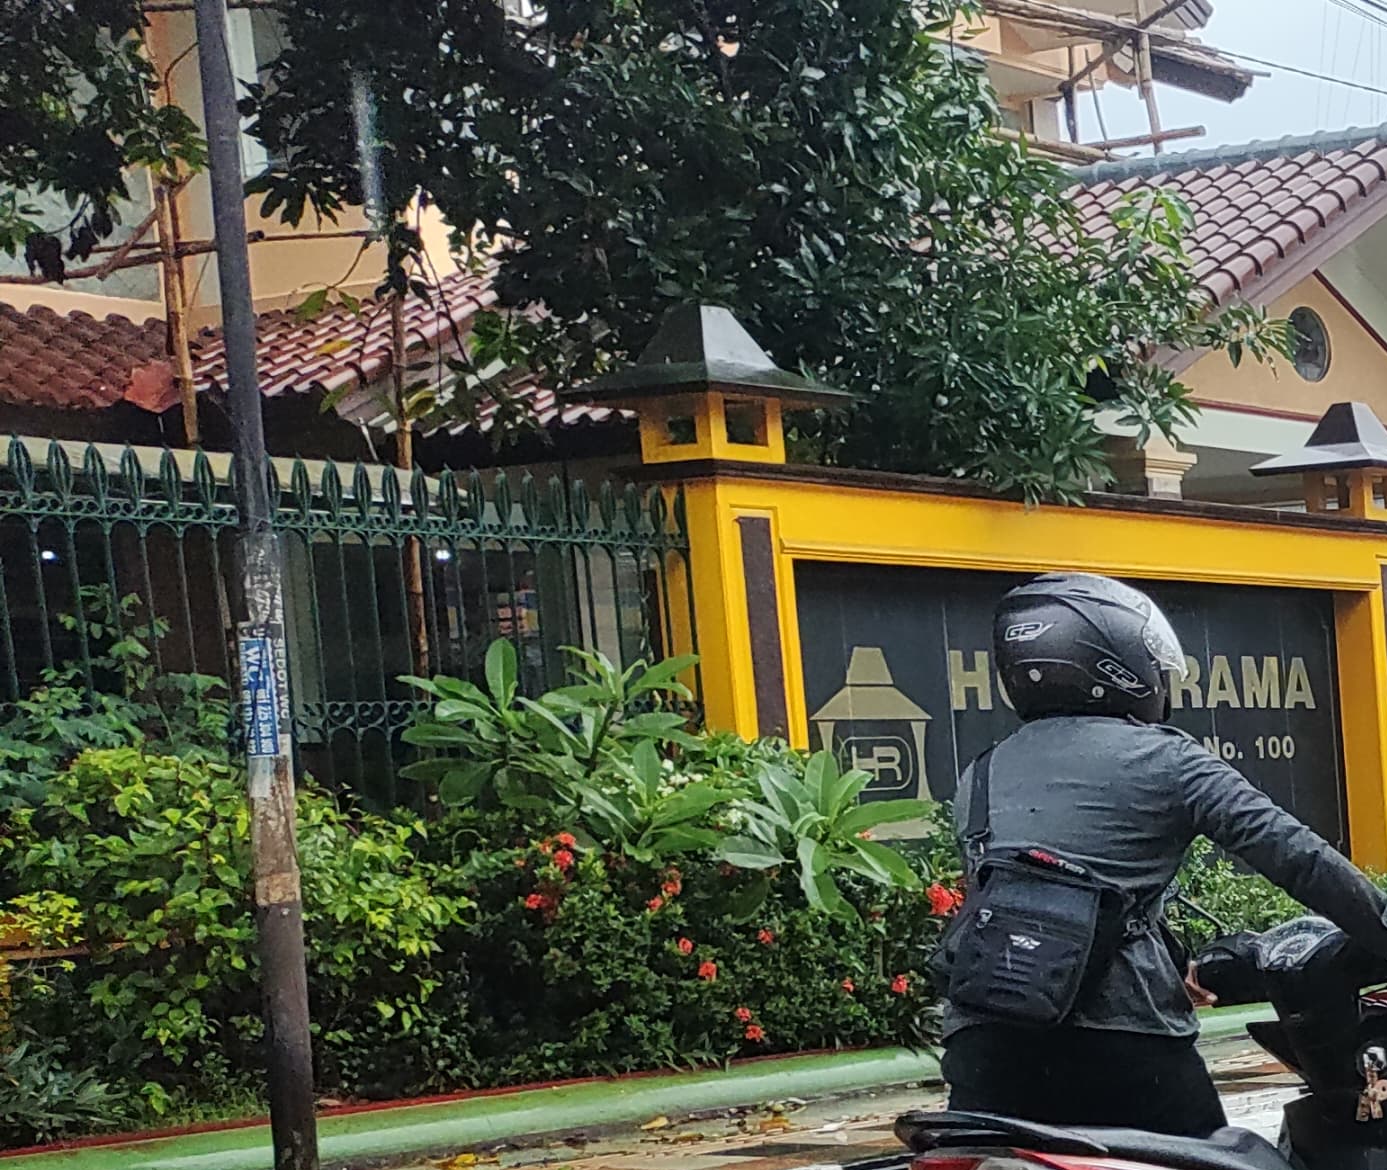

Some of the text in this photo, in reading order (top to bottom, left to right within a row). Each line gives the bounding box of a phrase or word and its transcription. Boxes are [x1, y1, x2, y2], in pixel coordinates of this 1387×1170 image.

[272, 637, 290, 720] SEDOT WC
[1171, 655, 1317, 710] RAMA
[1255, 735, 1295, 760] 100
